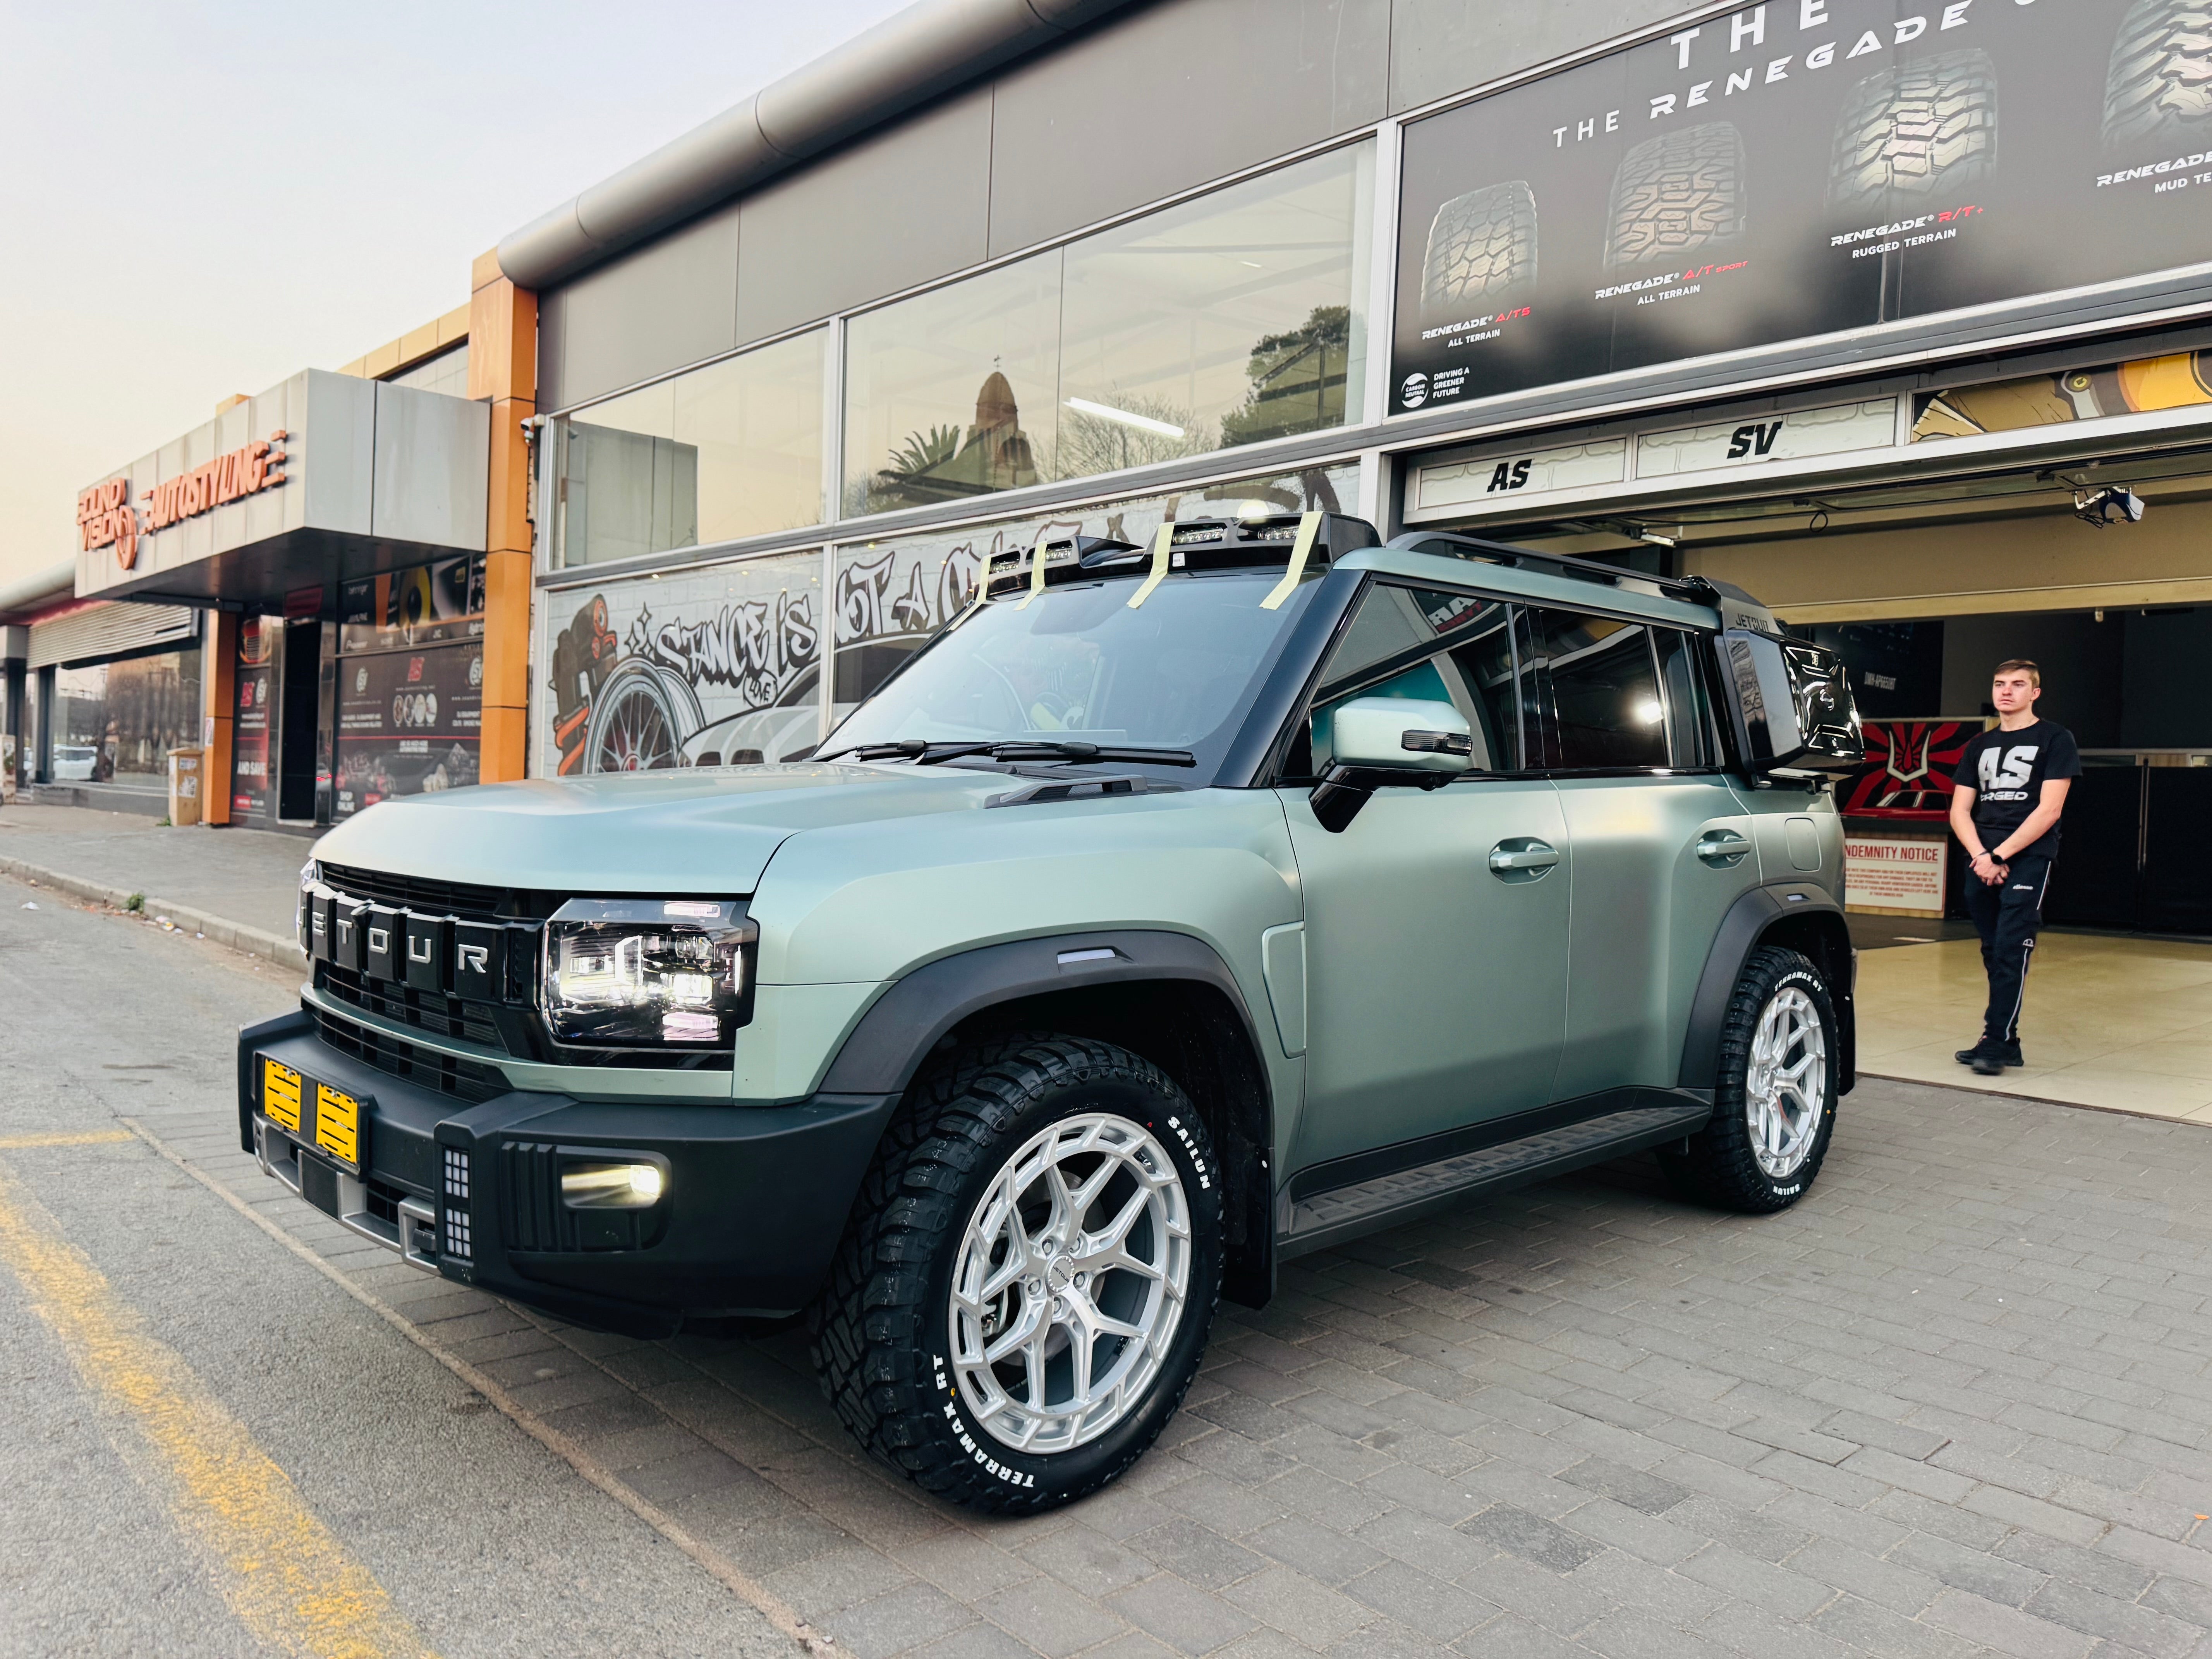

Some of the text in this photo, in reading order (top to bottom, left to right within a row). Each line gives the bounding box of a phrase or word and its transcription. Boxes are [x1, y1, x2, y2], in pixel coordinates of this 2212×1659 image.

[1671, 0, 1828, 69] THE
[1553, 0, 1972, 148] THE RENEGADE
[2155, 178, 2188, 193] MUD
[1852, 228, 1956, 259] RUGGED TERRAIN
[1683, 264, 1714, 280] A/T
[1716, 261, 1748, 273] SPORT
[1637, 284, 1700, 306] ALL TERRAIN
[1448, 329, 1500, 348] ALL TERRAIN
[1433, 377, 1465, 390] GREENER
[1434, 368, 1463, 381] DRIVING
[1432, 386, 1460, 399] FUTURE
[1727, 421, 1783, 459] SV
[149, 440, 270, 531] AUTOSTYLING
[1487, 458, 1532, 493] AS
[654, 601, 769, 685] STANCE
[776, 591, 817, 677] IS
[748, 679, 771, 702] LOVE
[1978, 745, 2040, 792] AS
[1845, 845, 1939, 861] NDEMNITY NOTICE
[1774, 971, 1823, 992] TERRAMAX RT
[1168, 1116, 1211, 1189] SAILUN
[1773, 1183, 1800, 1196] SAILUN
[933, 1354, 1034, 1488] TERRAMAX RT
